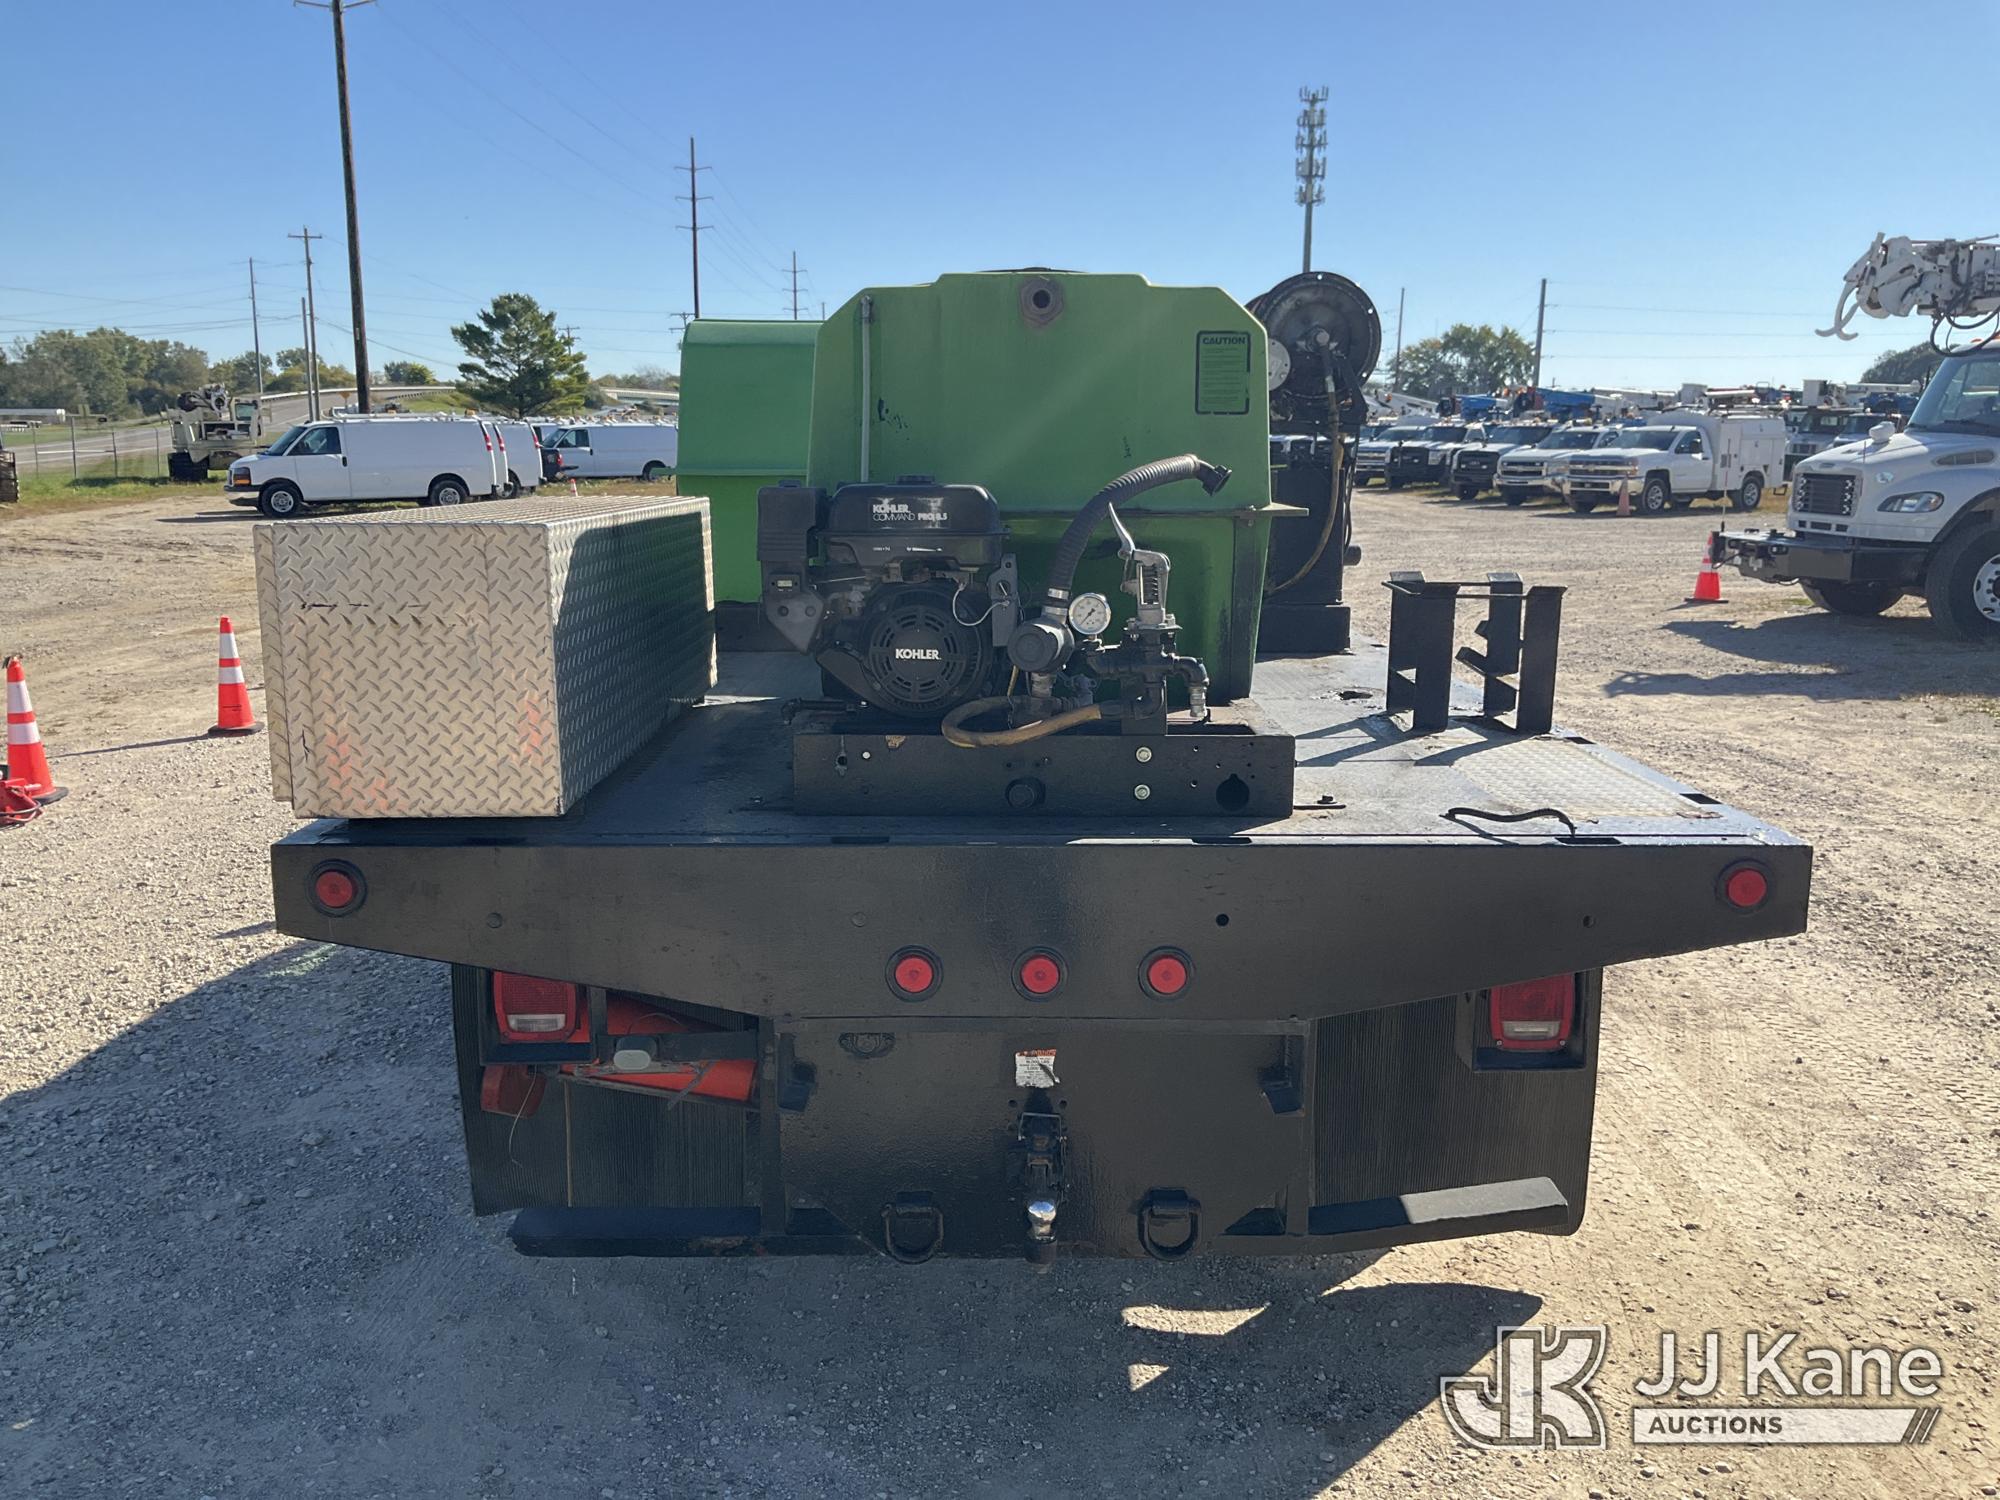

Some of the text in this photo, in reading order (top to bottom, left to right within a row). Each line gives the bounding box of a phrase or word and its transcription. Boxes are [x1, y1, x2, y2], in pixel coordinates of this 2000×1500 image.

[1202, 336, 1246, 345] CAUTION
[872, 504, 911, 514] KOHLER
[872, 513, 916, 521] COMMAND
[895, 648, 941, 660] KOHLER
